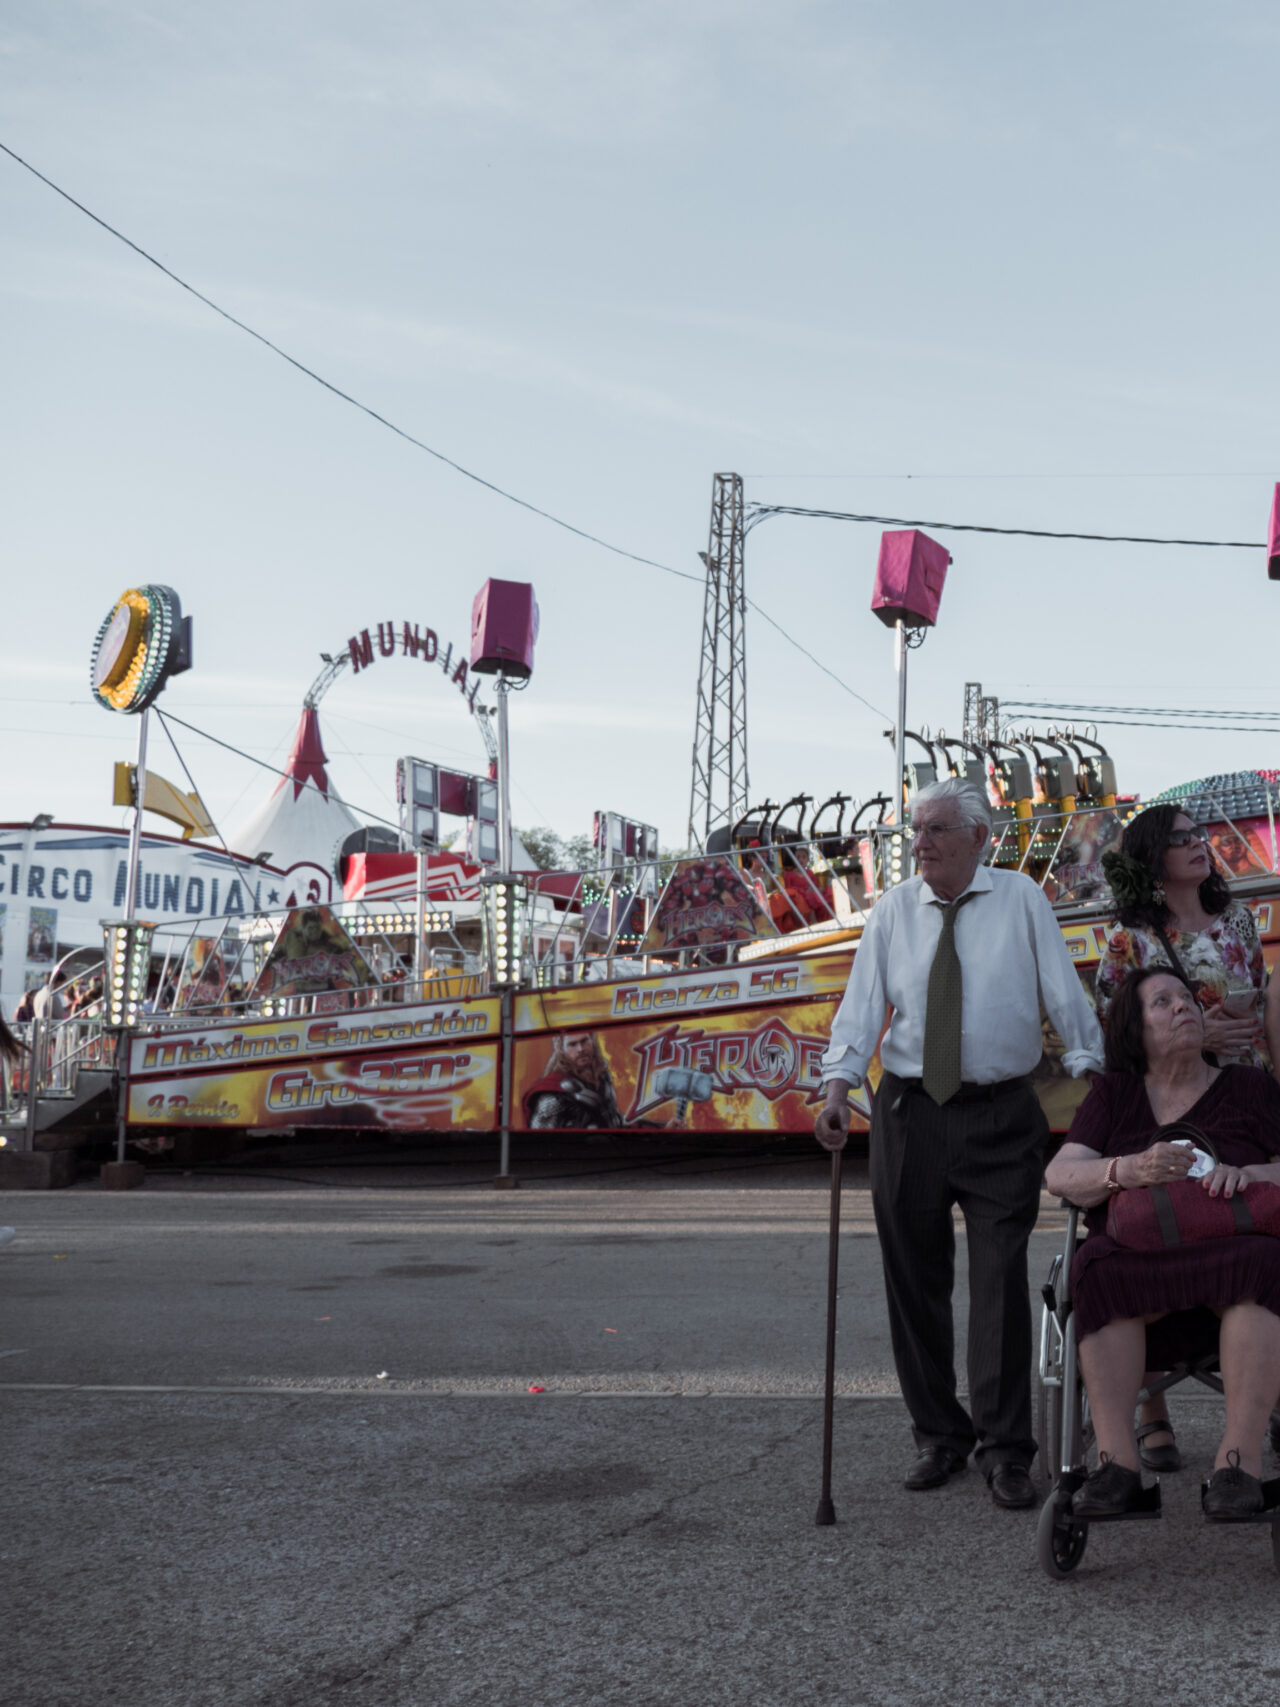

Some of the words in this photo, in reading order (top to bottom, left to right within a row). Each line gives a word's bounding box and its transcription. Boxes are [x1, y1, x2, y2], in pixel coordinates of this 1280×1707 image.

[613, 980, 740, 1015] Fuerza
[143, 1034, 299, 1068] Máxima
[306, 1011, 488, 1050] Sensación
